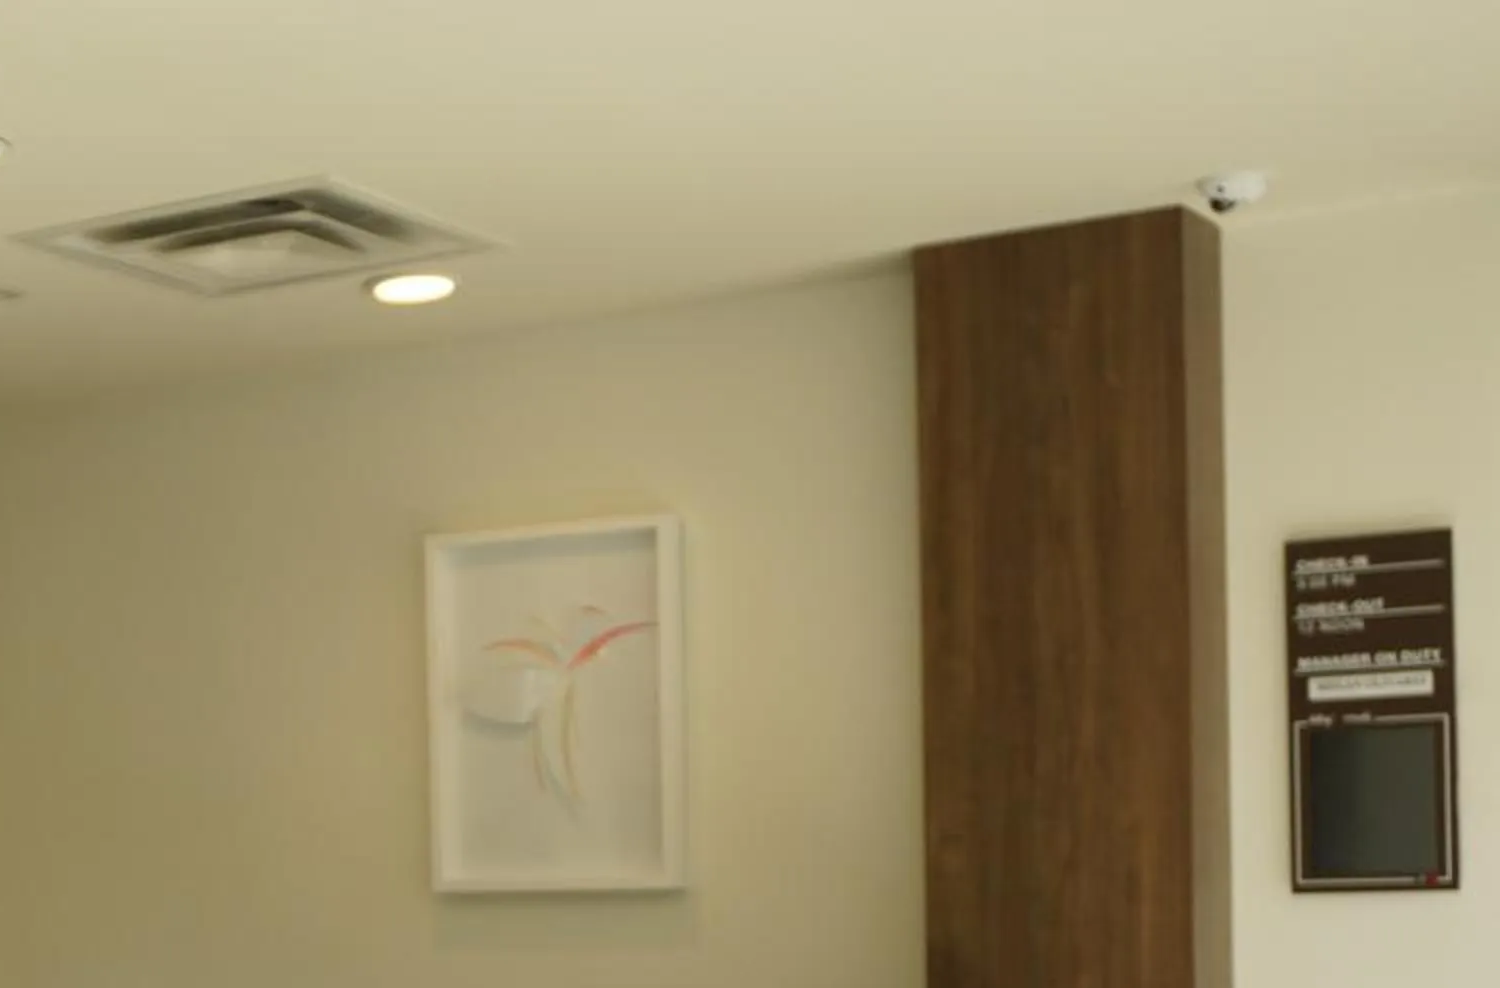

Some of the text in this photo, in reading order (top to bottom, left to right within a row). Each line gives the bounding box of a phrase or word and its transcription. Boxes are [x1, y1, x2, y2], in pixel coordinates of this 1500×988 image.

[1297, 648, 1441, 672] MANAGER ON DUTY
